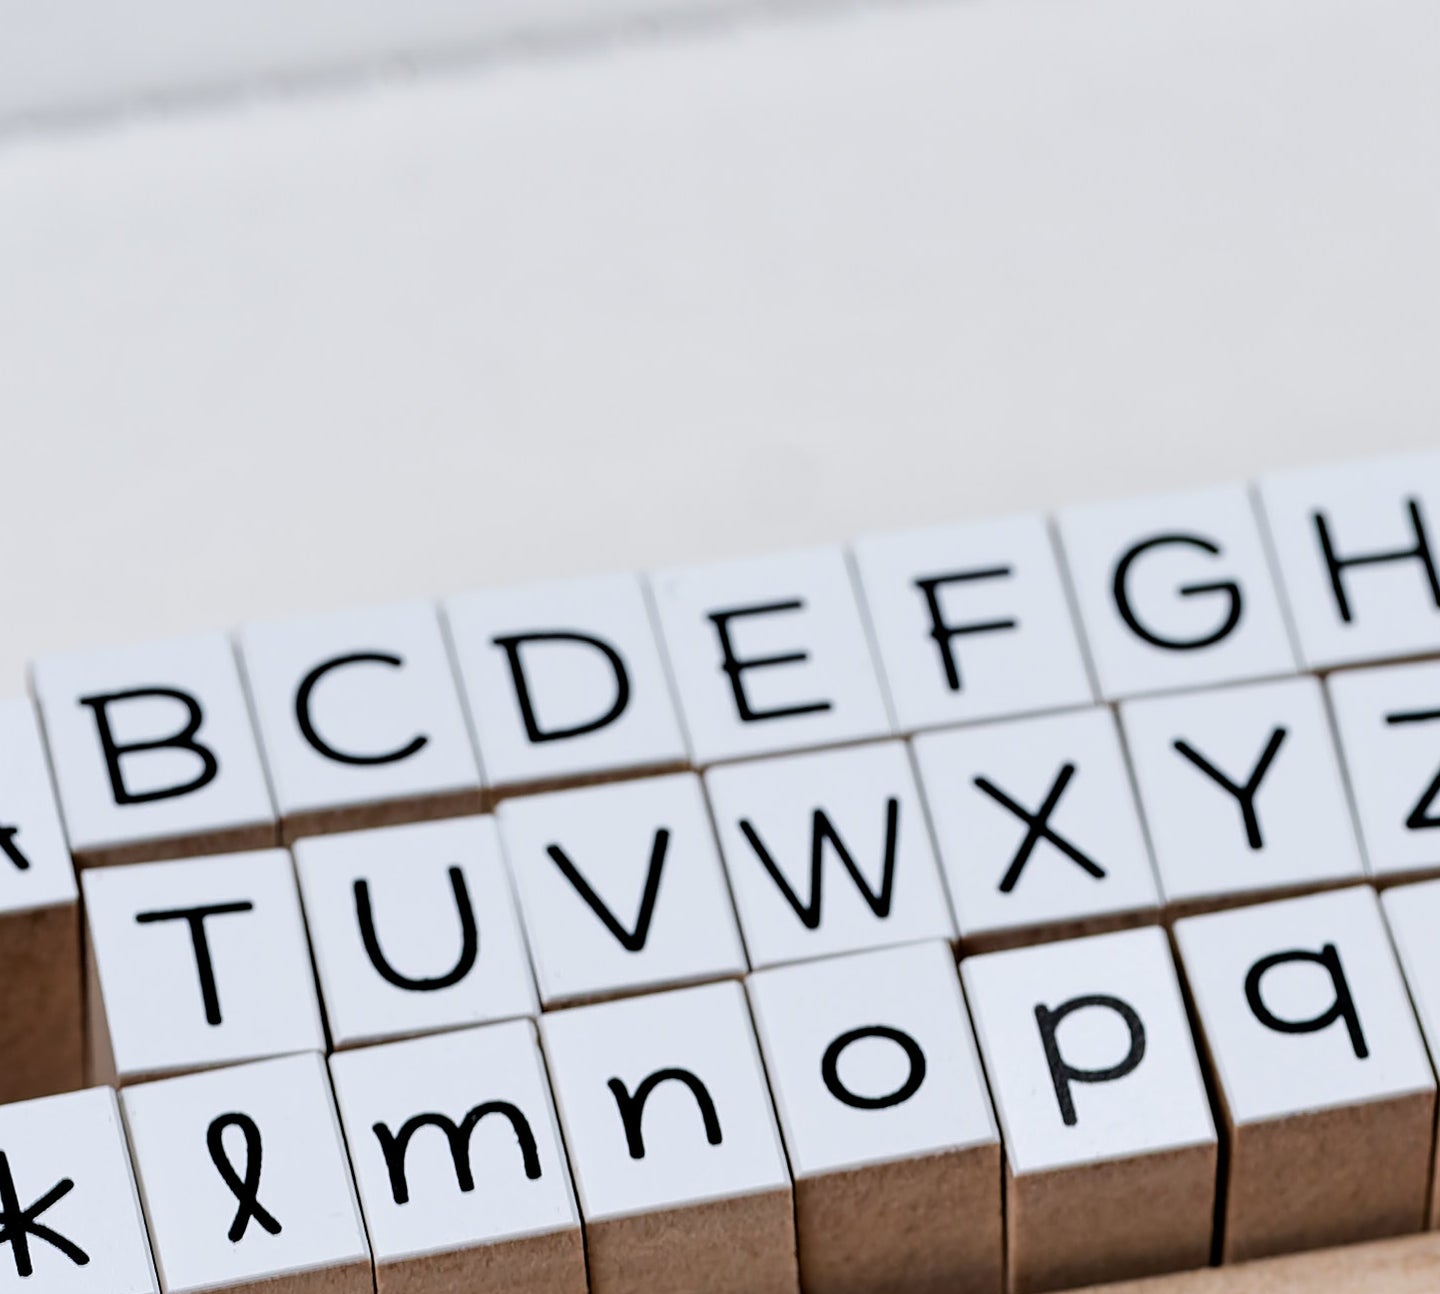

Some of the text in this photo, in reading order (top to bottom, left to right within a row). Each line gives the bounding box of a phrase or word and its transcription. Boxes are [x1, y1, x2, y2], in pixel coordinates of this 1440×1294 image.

[79, 687, 219, 806] B
[294, 652, 428, 767] C
[492, 631, 631, 744] D
[707, 600, 832, 723] E
[914, 567, 1016, 692] F
[1111, 534, 1243, 652] G
[135, 901, 253, 1026] T
[353, 866, 478, 992] U
[546, 828, 670, 953] V
[739, 797, 899, 930] W
[973, 763, 1106, 894] X
[1173, 727, 1287, 851] Y
[372, 1100, 543, 1205] m
[607, 1068, 722, 1159] n
[821, 1025, 926, 1110] o
[1034, 994, 1146, 1126] p
[1244, 943, 1369, 1060] q
